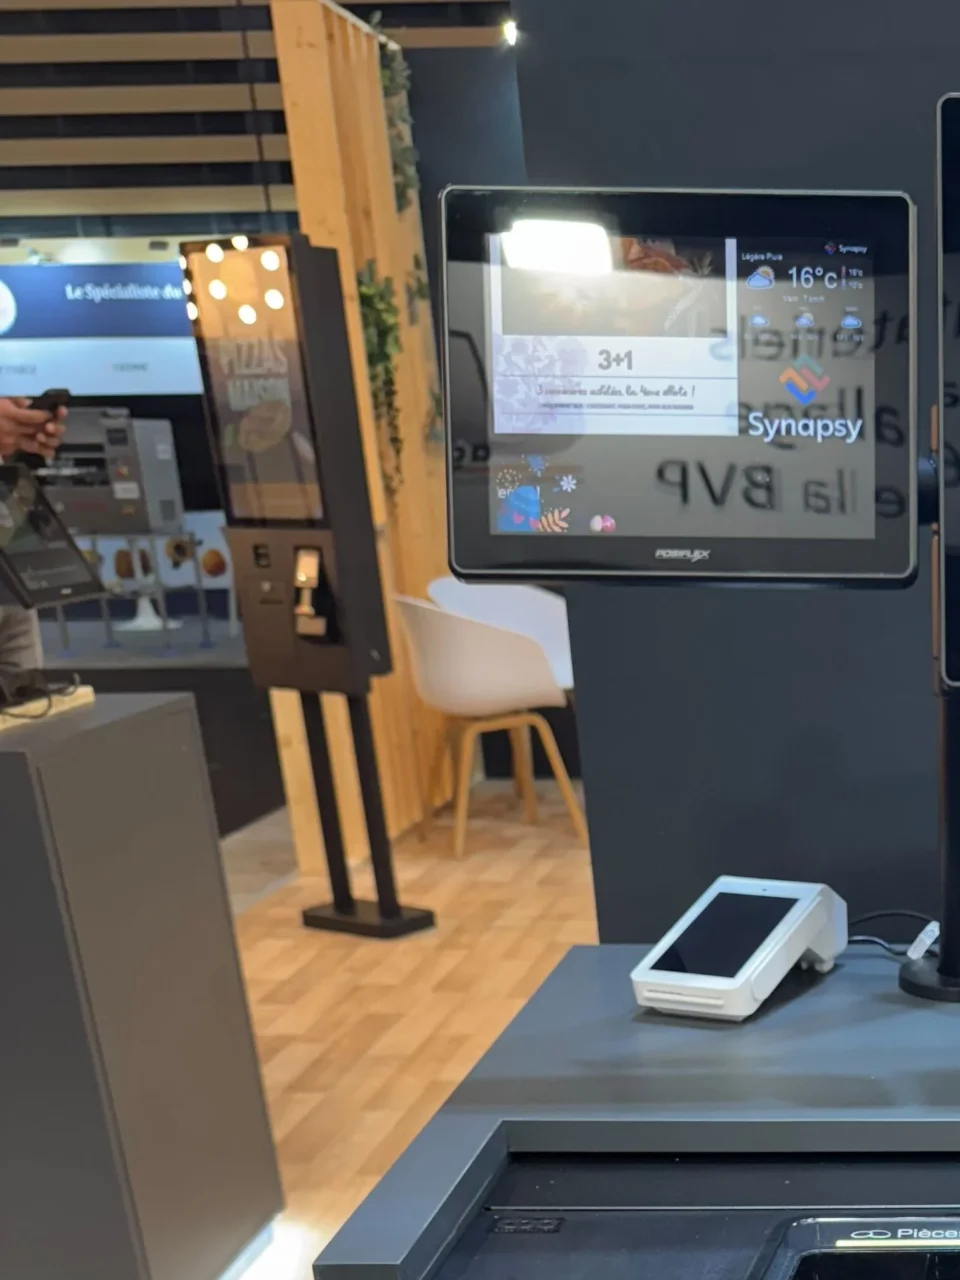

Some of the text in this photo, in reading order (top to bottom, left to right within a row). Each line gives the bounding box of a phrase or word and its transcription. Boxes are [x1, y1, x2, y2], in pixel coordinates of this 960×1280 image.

[65, 283, 84, 300] Le
[598, 349, 633, 370] 3+1
[748, 411, 863, 443] Synapsy
